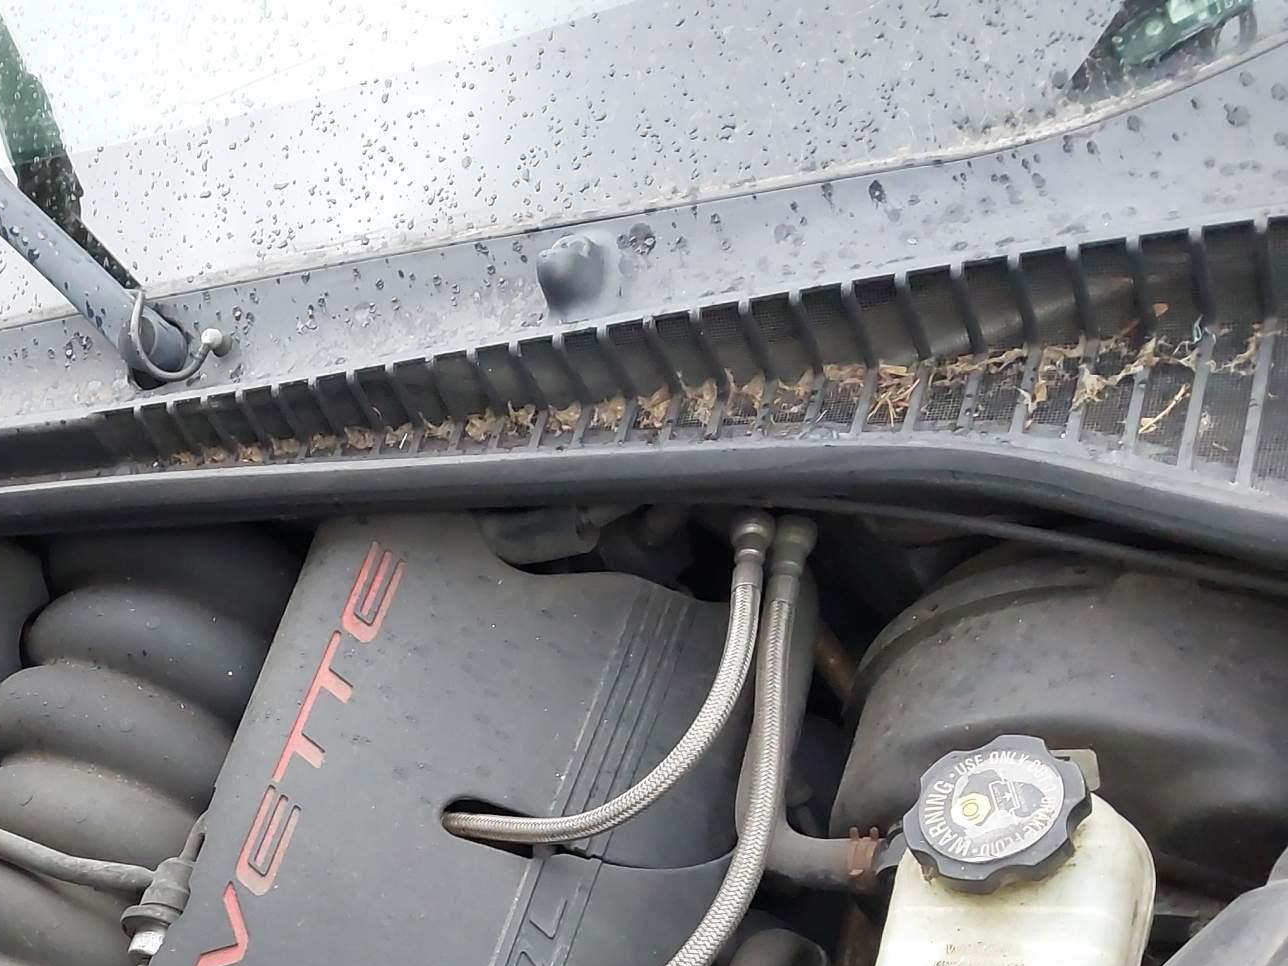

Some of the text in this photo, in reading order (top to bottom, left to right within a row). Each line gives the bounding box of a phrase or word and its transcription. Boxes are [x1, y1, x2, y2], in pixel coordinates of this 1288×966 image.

[923, 779, 973, 857] WARNING
[955, 754, 984, 775] USE
[989, 751, 1030, 764] ONLY
[1023, 795, 1058, 833] BRAKE
